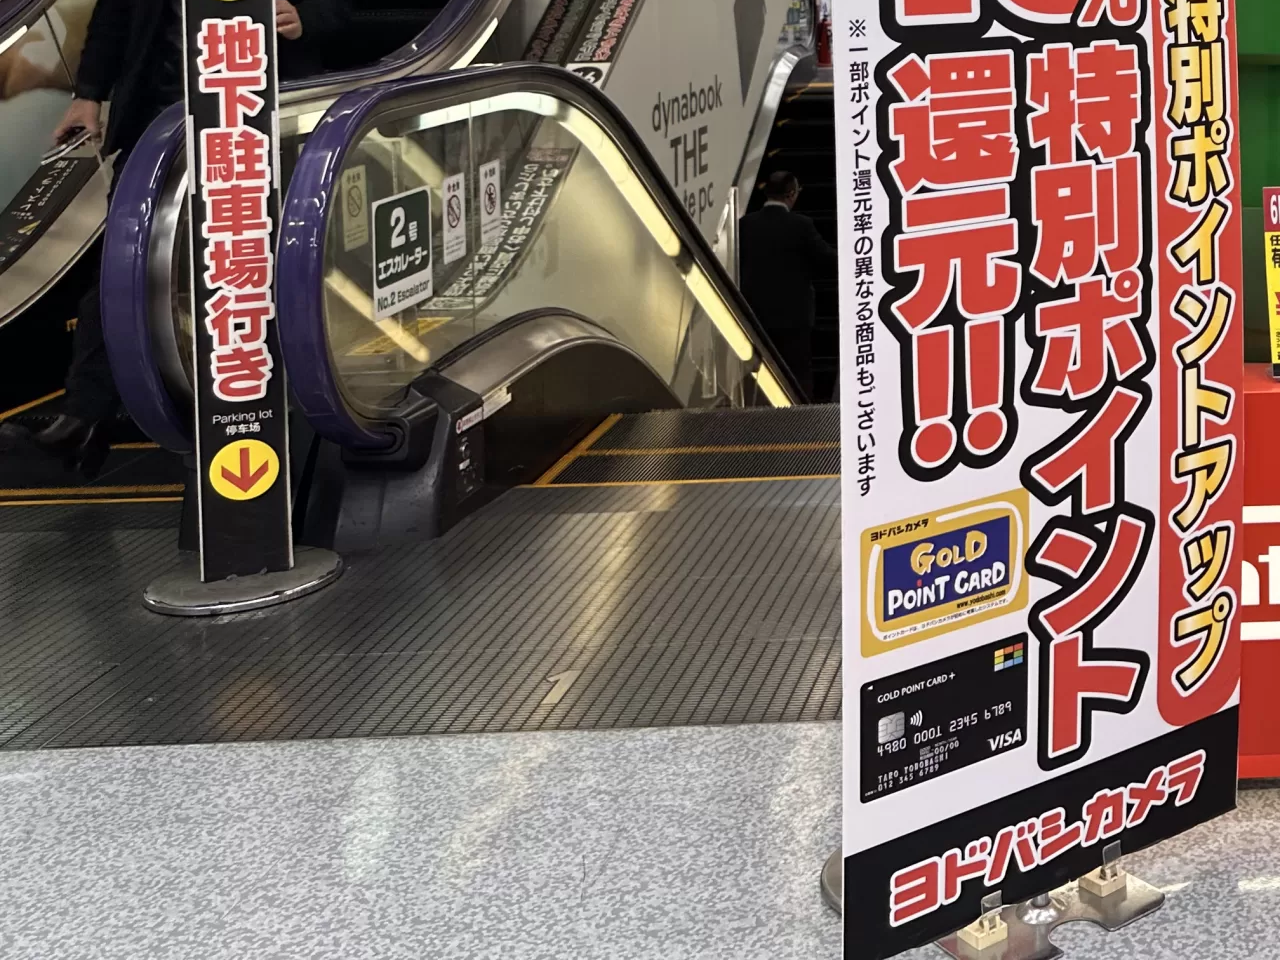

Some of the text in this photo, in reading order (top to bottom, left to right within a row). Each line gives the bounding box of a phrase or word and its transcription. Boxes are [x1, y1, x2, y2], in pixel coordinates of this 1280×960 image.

[652, 74, 723, 138] dynabook
[670, 125, 708, 187] THE
[197, 16, 278, 402] 地下駐車場行き
[390, 205, 419, 249] 2号
[378, 246, 428, 281] エスカレーター
[848, 19, 877, 496] ※一部ポイント還元率の異なる商品もございます
[377, 279, 430, 313] No.2 Escalator
[212, 408, 273, 425] Parking lot
[1025, 40, 1156, 761] 特別ポイント
[225, 421, 261, 437] 停车场
[870, 518, 929, 542] ヨドバシカメラ
[910, 530, 988, 576] GOLD
[954, 561, 1006, 595] CARD
[877, 690, 900, 703] GOLD
[901, 681, 925, 696] POINT
[926, 674, 948, 688] CARD
[877, 737, 907, 757] 4980
[913, 725, 943, 745] 0001
[949, 712, 978, 733] 2345
[984, 701, 1012, 720] 6789
[987, 728, 1023, 751] VISA
[934, 740, 960, 755] 00/00
[877, 770, 899, 784] TARO
[877, 765, 940, 792] 012 345 6789
[888, 750, 1206, 927] ヨドバシカメラ
